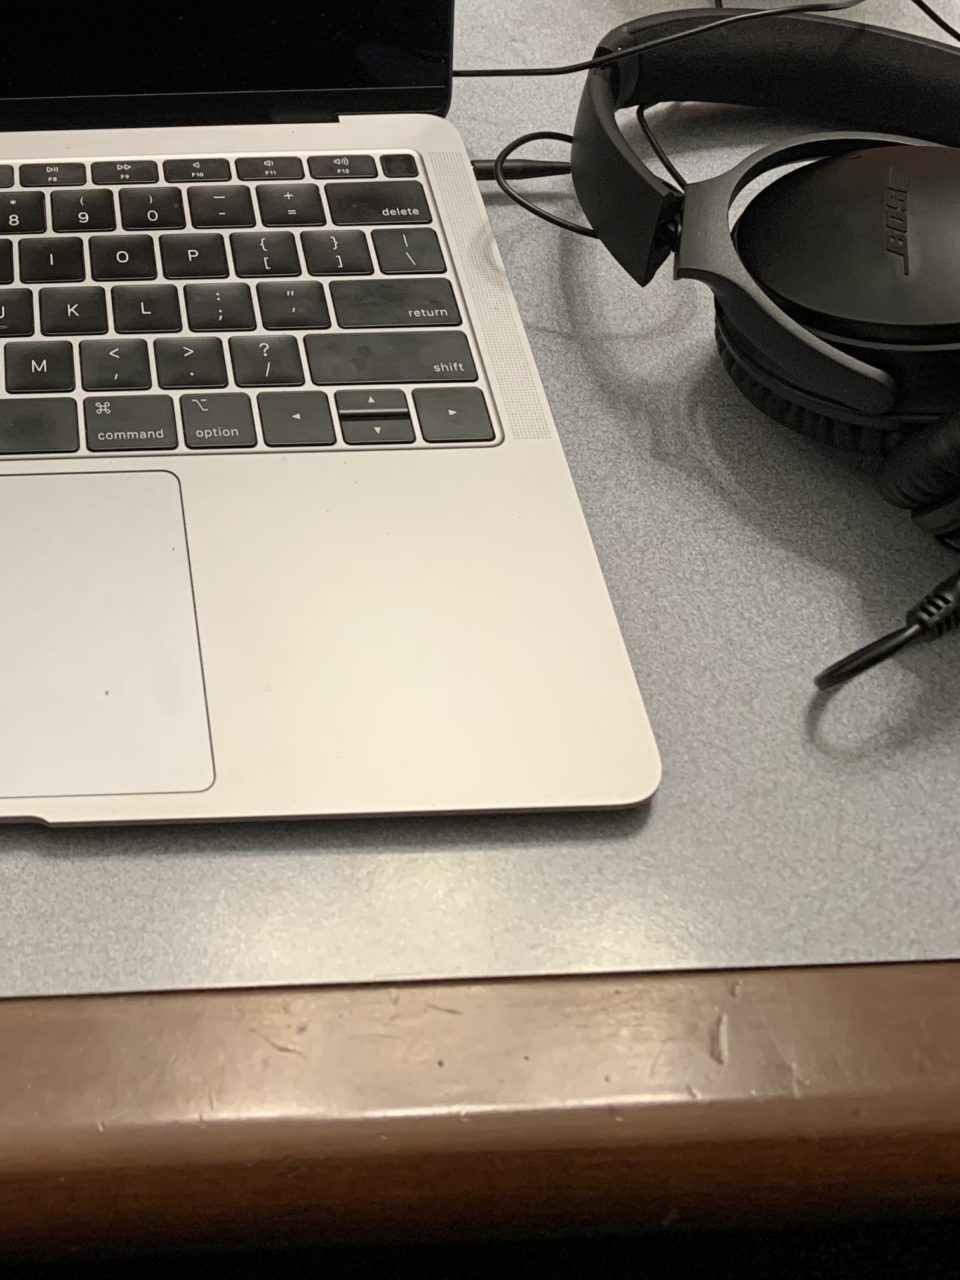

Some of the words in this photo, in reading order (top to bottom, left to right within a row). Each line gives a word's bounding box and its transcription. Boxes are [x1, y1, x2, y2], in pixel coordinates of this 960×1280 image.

[283, 191, 294, 200] +
[77, 211, 89, 224] 9
[146, 209, 159, 222] 0
[381, 207, 420, 216] delete
[8, 214, 20, 226] 8
[885, 167, 911, 277] BOSE
[259, 237, 268, 252] {
[329, 235, 339, 250] }
[115, 250, 129, 264] O
[187, 249, 199, 262] P
[335, 254, 344, 268] ]
[263, 256, 271, 270] [
[67, 303, 80, 317] K
[140, 301, 152, 315] L
[408, 308, 449, 318] return
[108, 347, 120, 359] <
[182, 346, 195, 357] >
[258, 342, 270, 357] ?
[31, 358, 47, 373] M
[433, 362, 465, 373] shift
[97, 428, 164, 441] command
[195, 426, 239, 440] option
